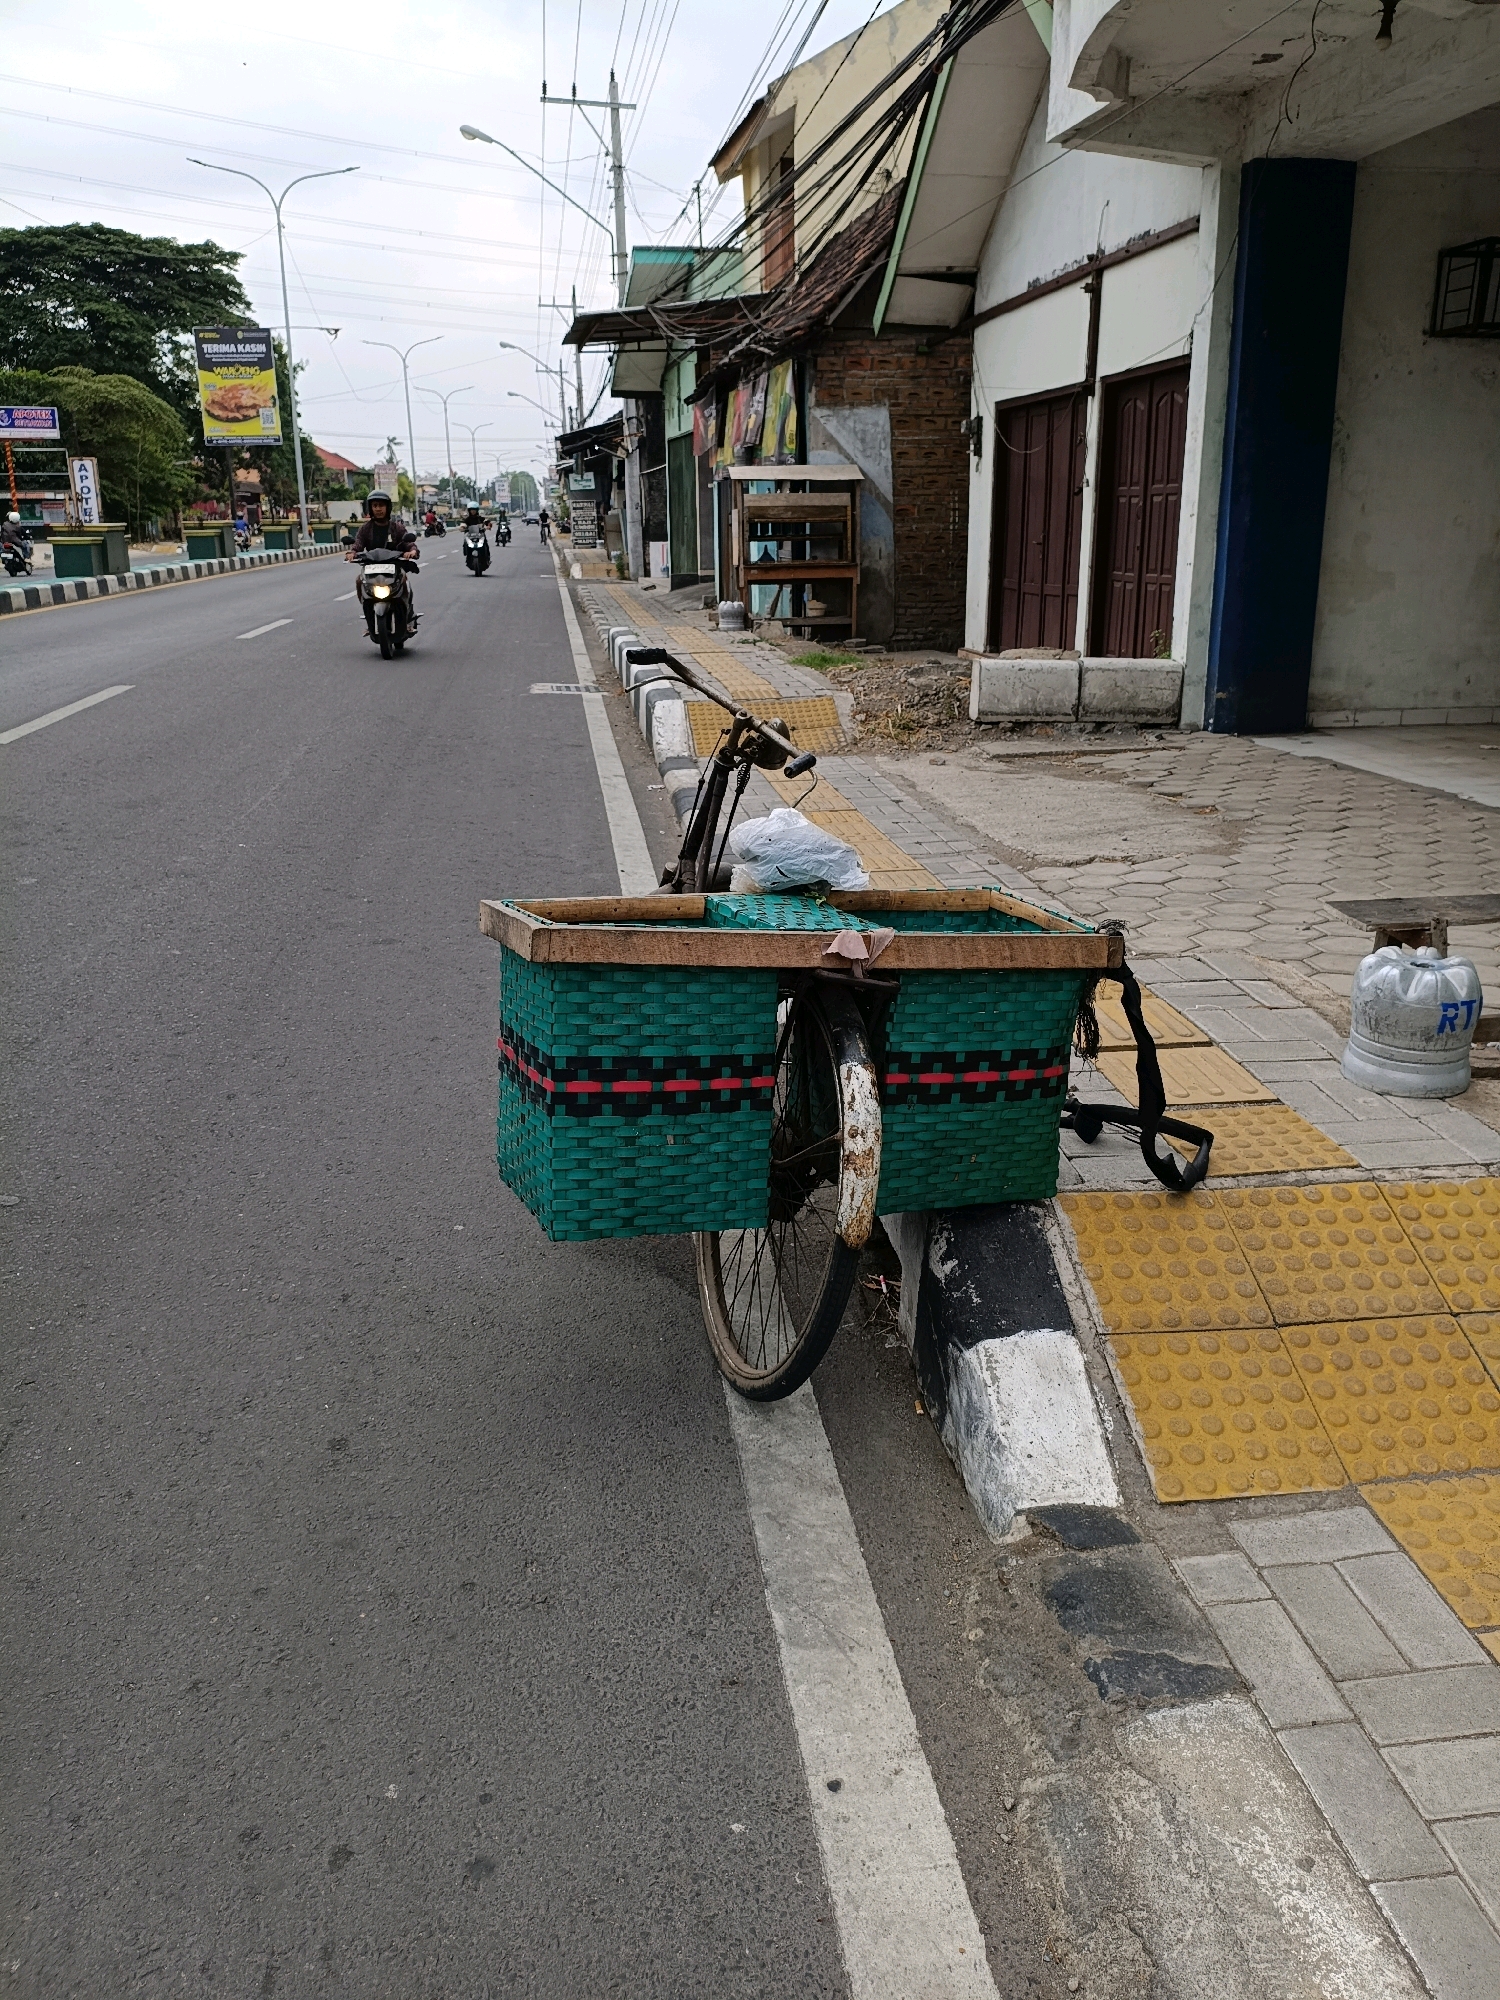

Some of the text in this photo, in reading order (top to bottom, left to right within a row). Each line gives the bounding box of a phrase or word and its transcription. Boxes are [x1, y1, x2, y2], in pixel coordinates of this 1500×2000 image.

[202, 343, 267, 353] TERIMA KASIH
[12, 409, 53, 420] APOTEK
[1437, 999, 1476, 1035] RT
